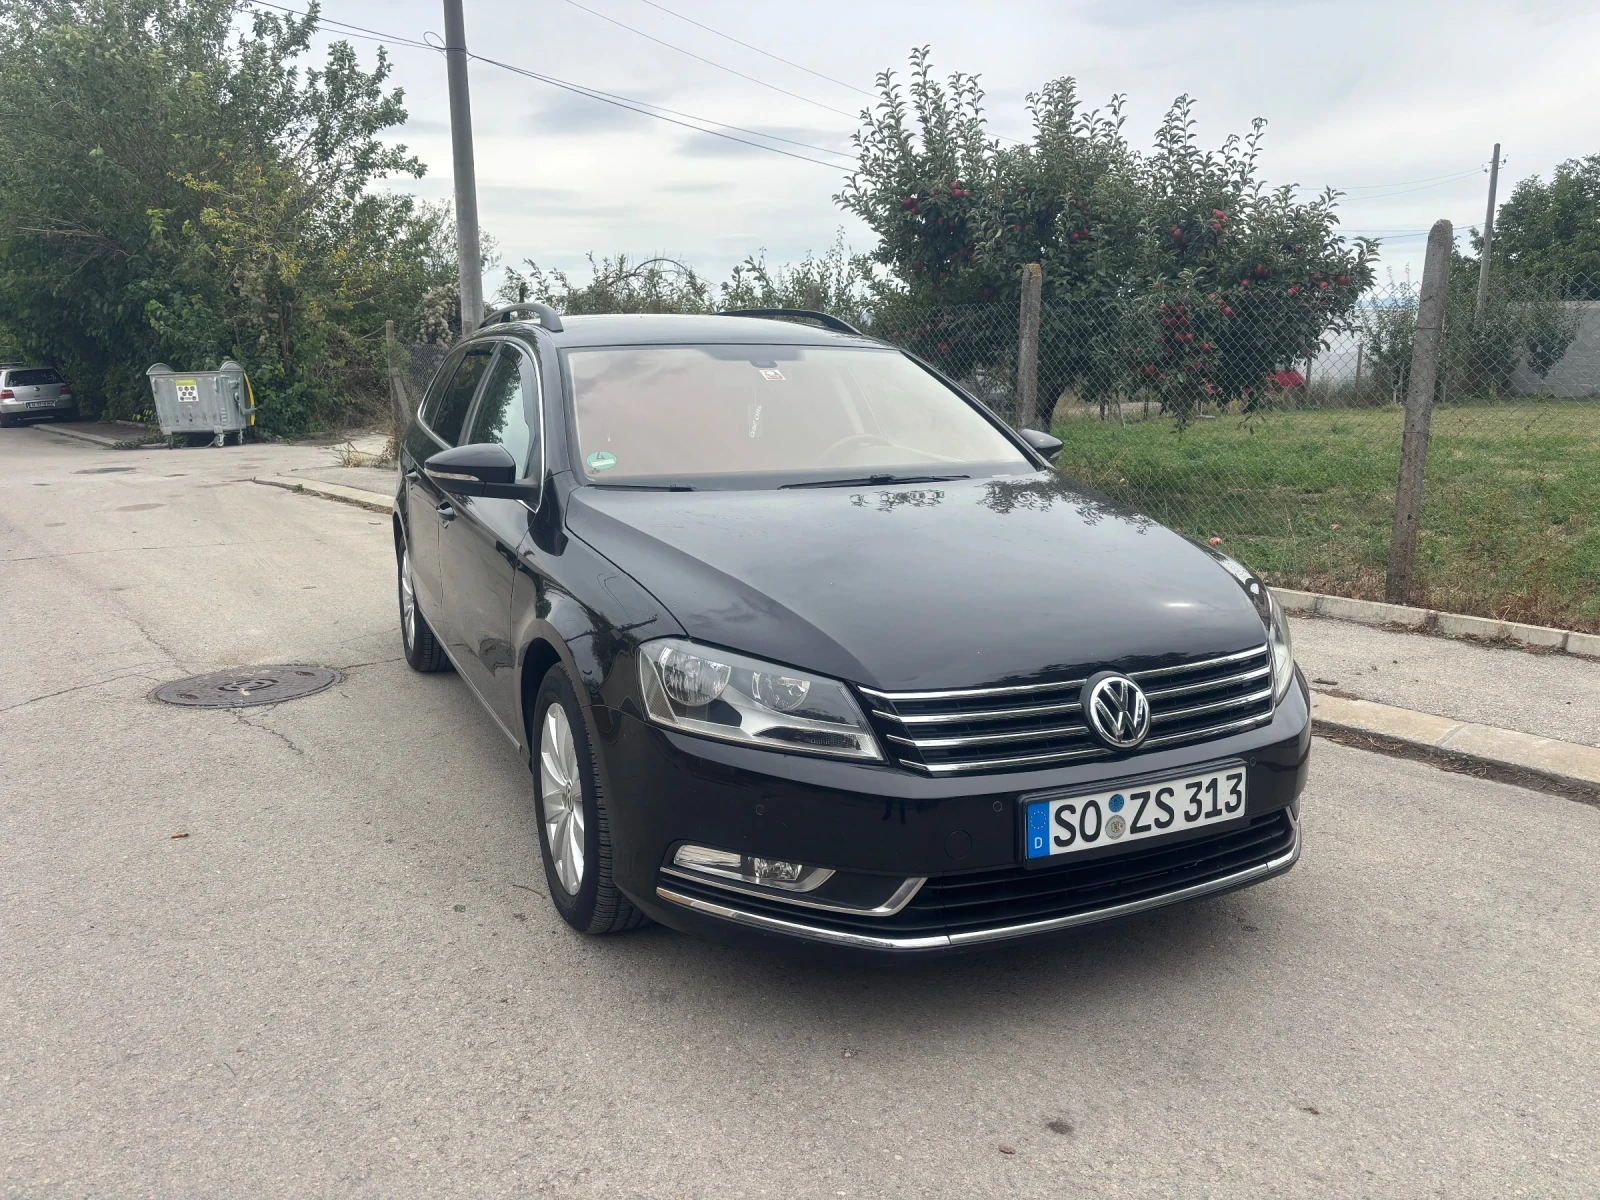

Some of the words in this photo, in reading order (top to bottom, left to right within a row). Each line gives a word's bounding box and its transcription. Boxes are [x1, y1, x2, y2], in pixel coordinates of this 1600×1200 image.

[596, 451, 605, 460] 4
[1034, 836, 1043, 849] D
[1053, 799, 1102, 848] SO
[1129, 787, 1175, 835] ZS
[1183, 772, 1243, 823] 313
